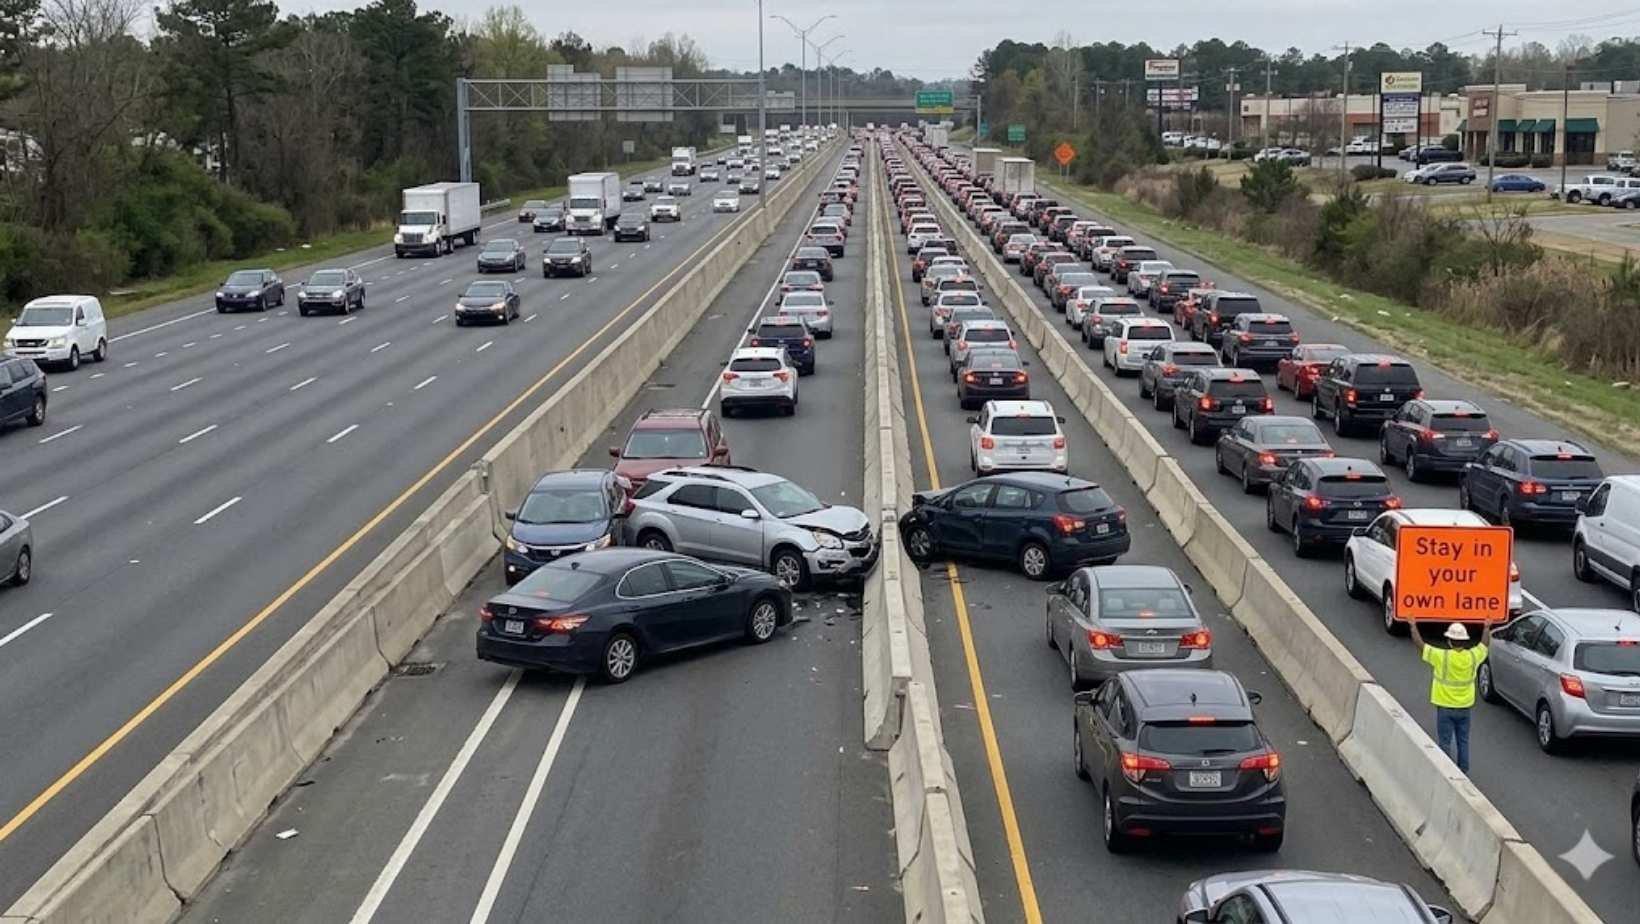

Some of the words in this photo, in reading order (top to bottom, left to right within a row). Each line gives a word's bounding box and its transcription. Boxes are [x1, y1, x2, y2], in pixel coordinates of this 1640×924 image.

[1416, 537, 1464, 561] Stay
[1474, 538, 1492, 557] in
[1428, 568, 1477, 586] your
[1403, 594, 1445, 608] own
[1456, 592, 1500, 610] lane
